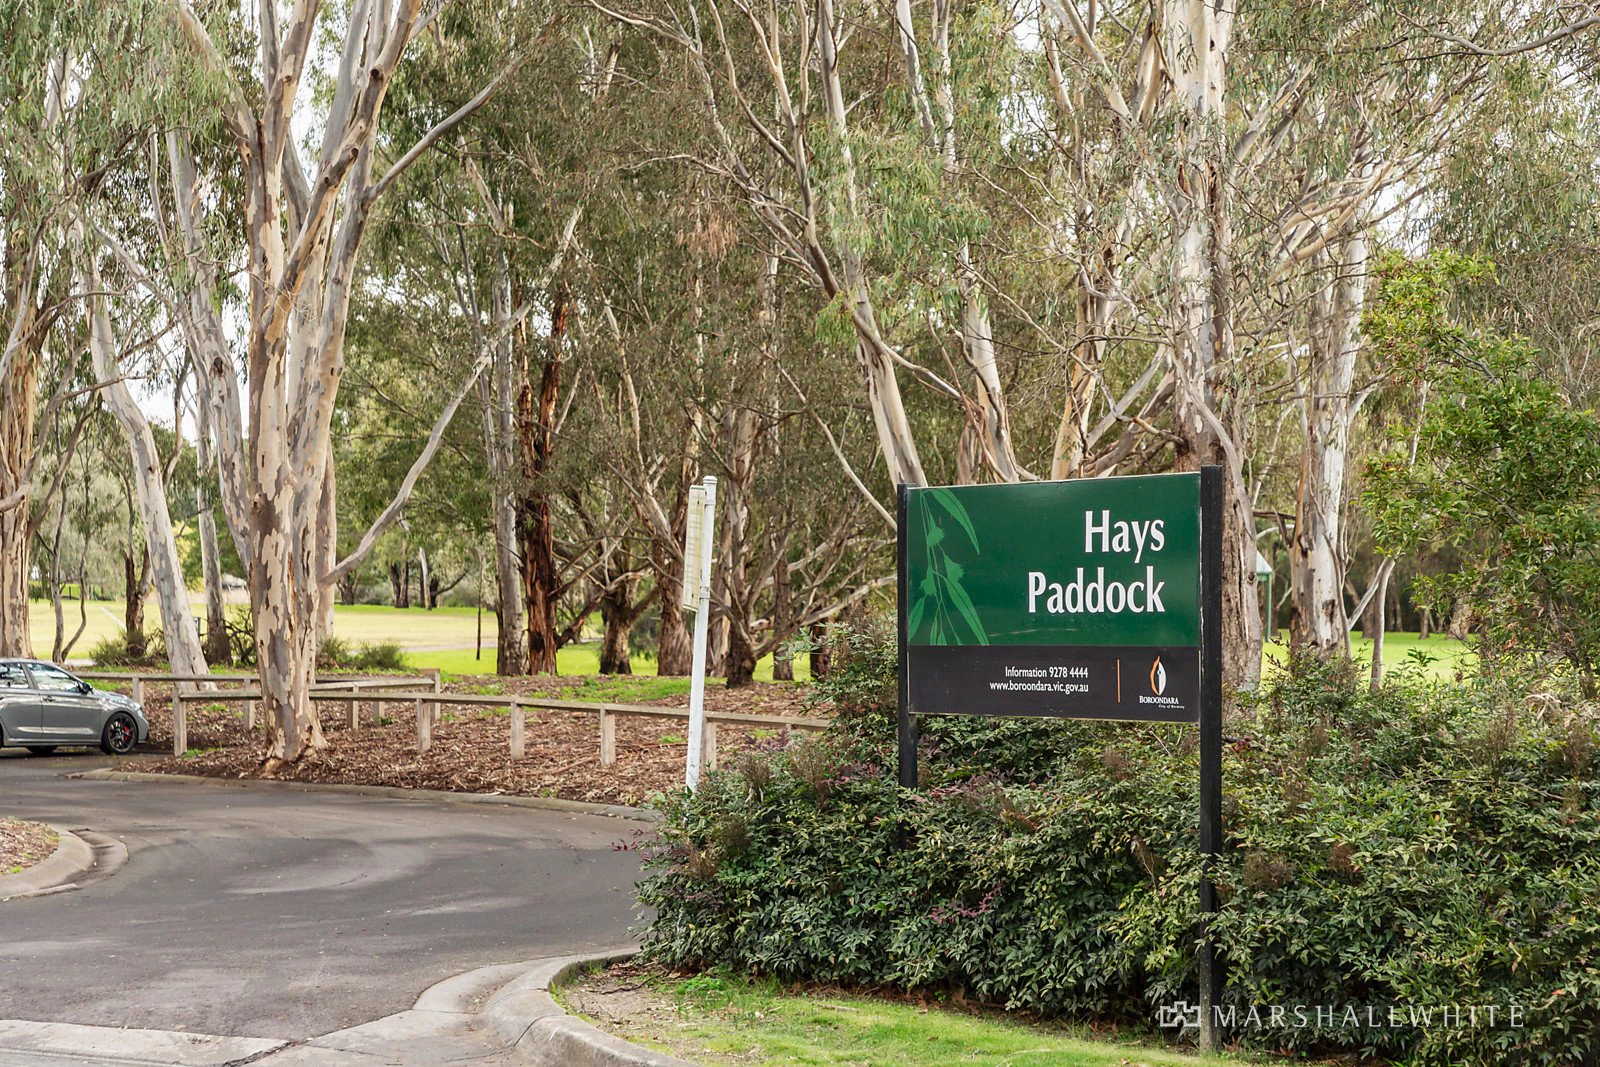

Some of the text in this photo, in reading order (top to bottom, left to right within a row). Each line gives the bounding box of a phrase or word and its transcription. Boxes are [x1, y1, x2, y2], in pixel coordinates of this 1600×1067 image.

[1085, 510, 1165, 563] Hays
[1028, 565, 1166, 613] Paddock
[1005, 666, 1089, 679] Information 9278 4444
[989, 680, 1089, 695] www.boroondara.vic.gov.au
[1139, 695, 1179, 704] BOROONDARA
